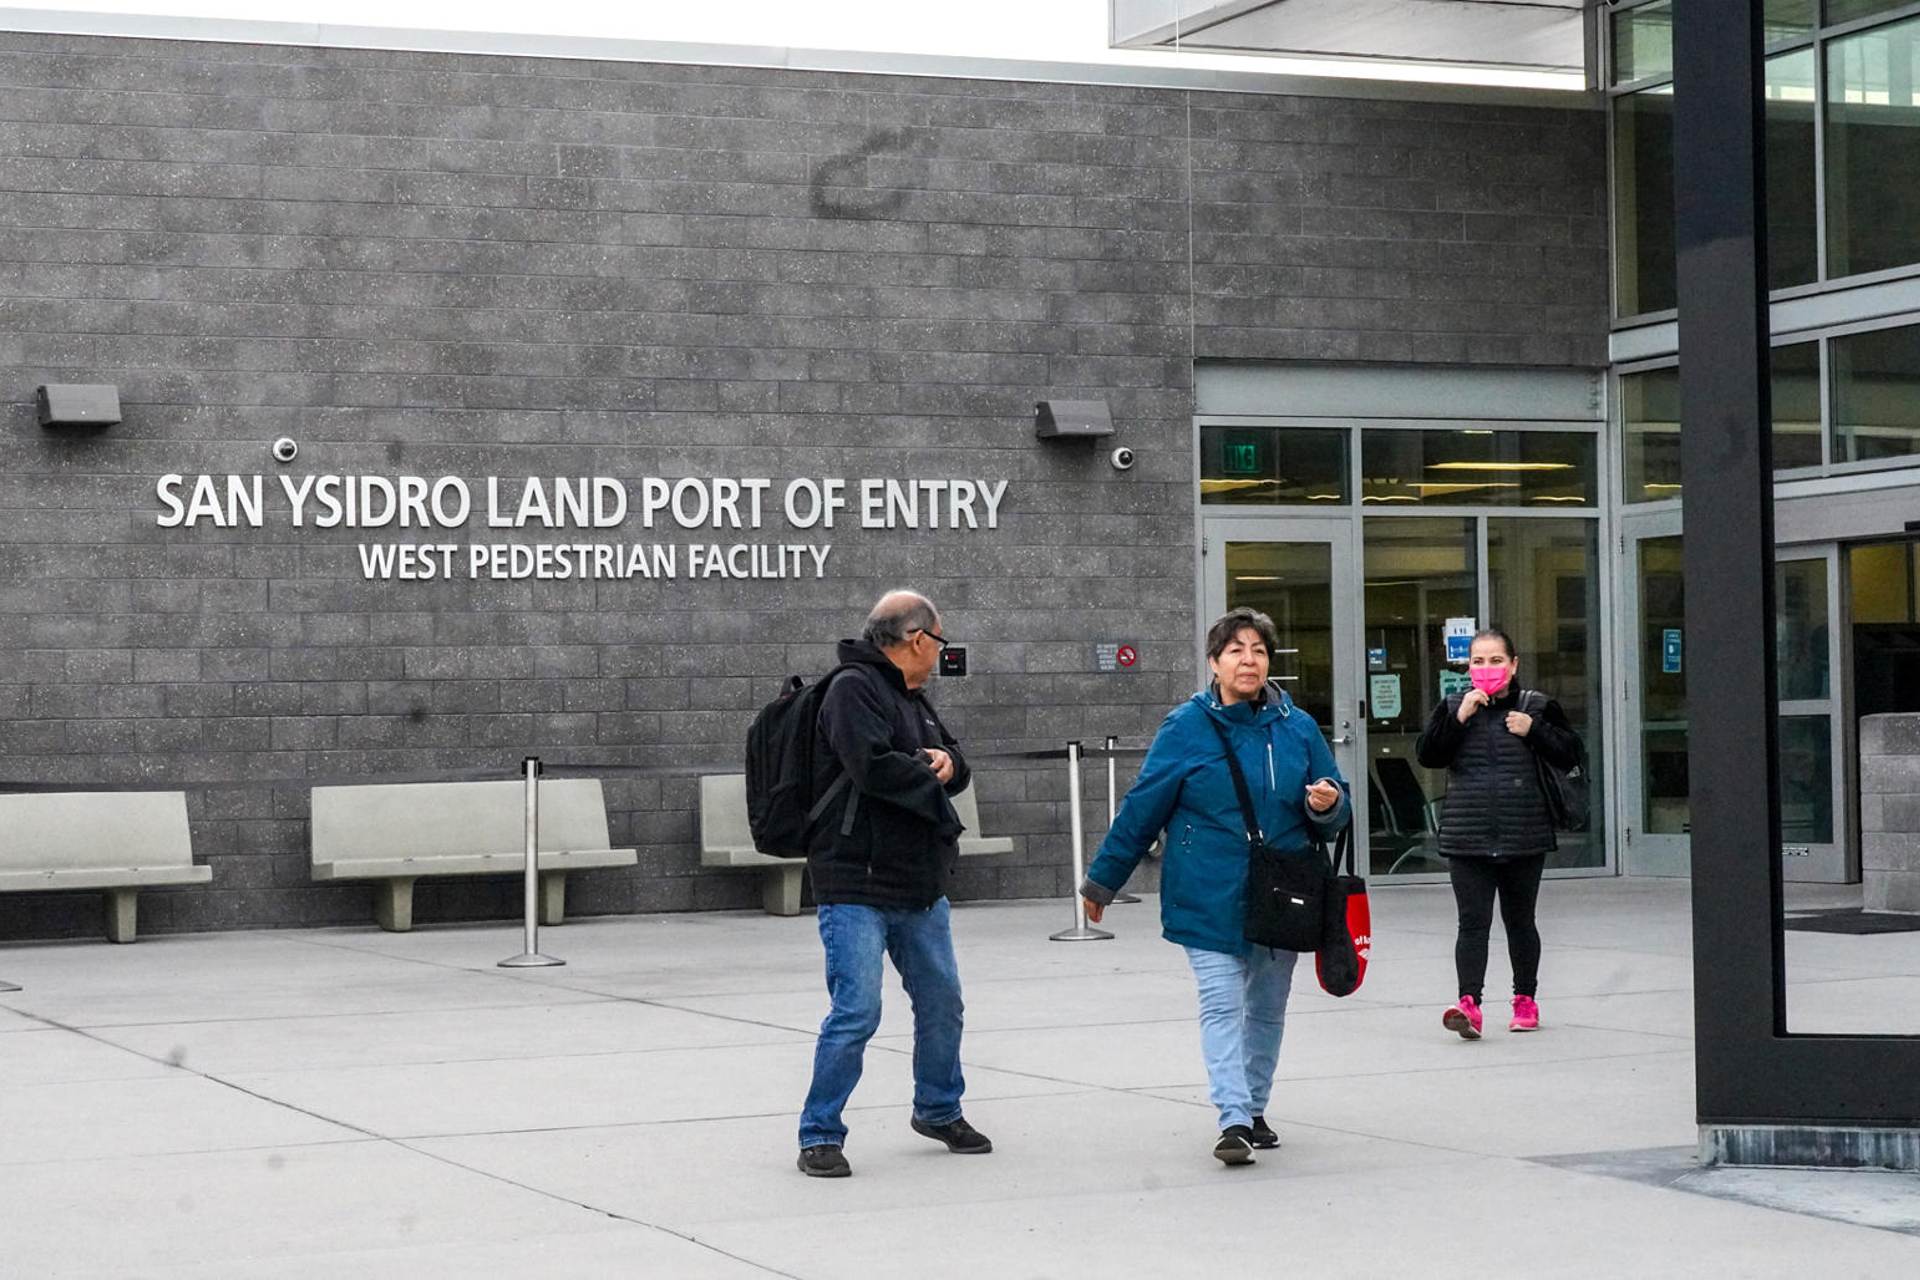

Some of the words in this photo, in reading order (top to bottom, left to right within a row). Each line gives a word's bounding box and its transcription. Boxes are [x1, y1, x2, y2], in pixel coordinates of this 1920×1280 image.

[156, 474, 264, 528] SAN
[278, 474, 471, 528] YSIDRO
[487, 475, 628, 528] LAND
[643, 476, 771, 529] PORT
[784, 477, 846, 529] OF
[861, 478, 1009, 530] ENTRY
[358, 543, 458, 580] WEST
[470, 542, 676, 579] PEDESTRIAN
[688, 543, 832, 579] FACILITY
